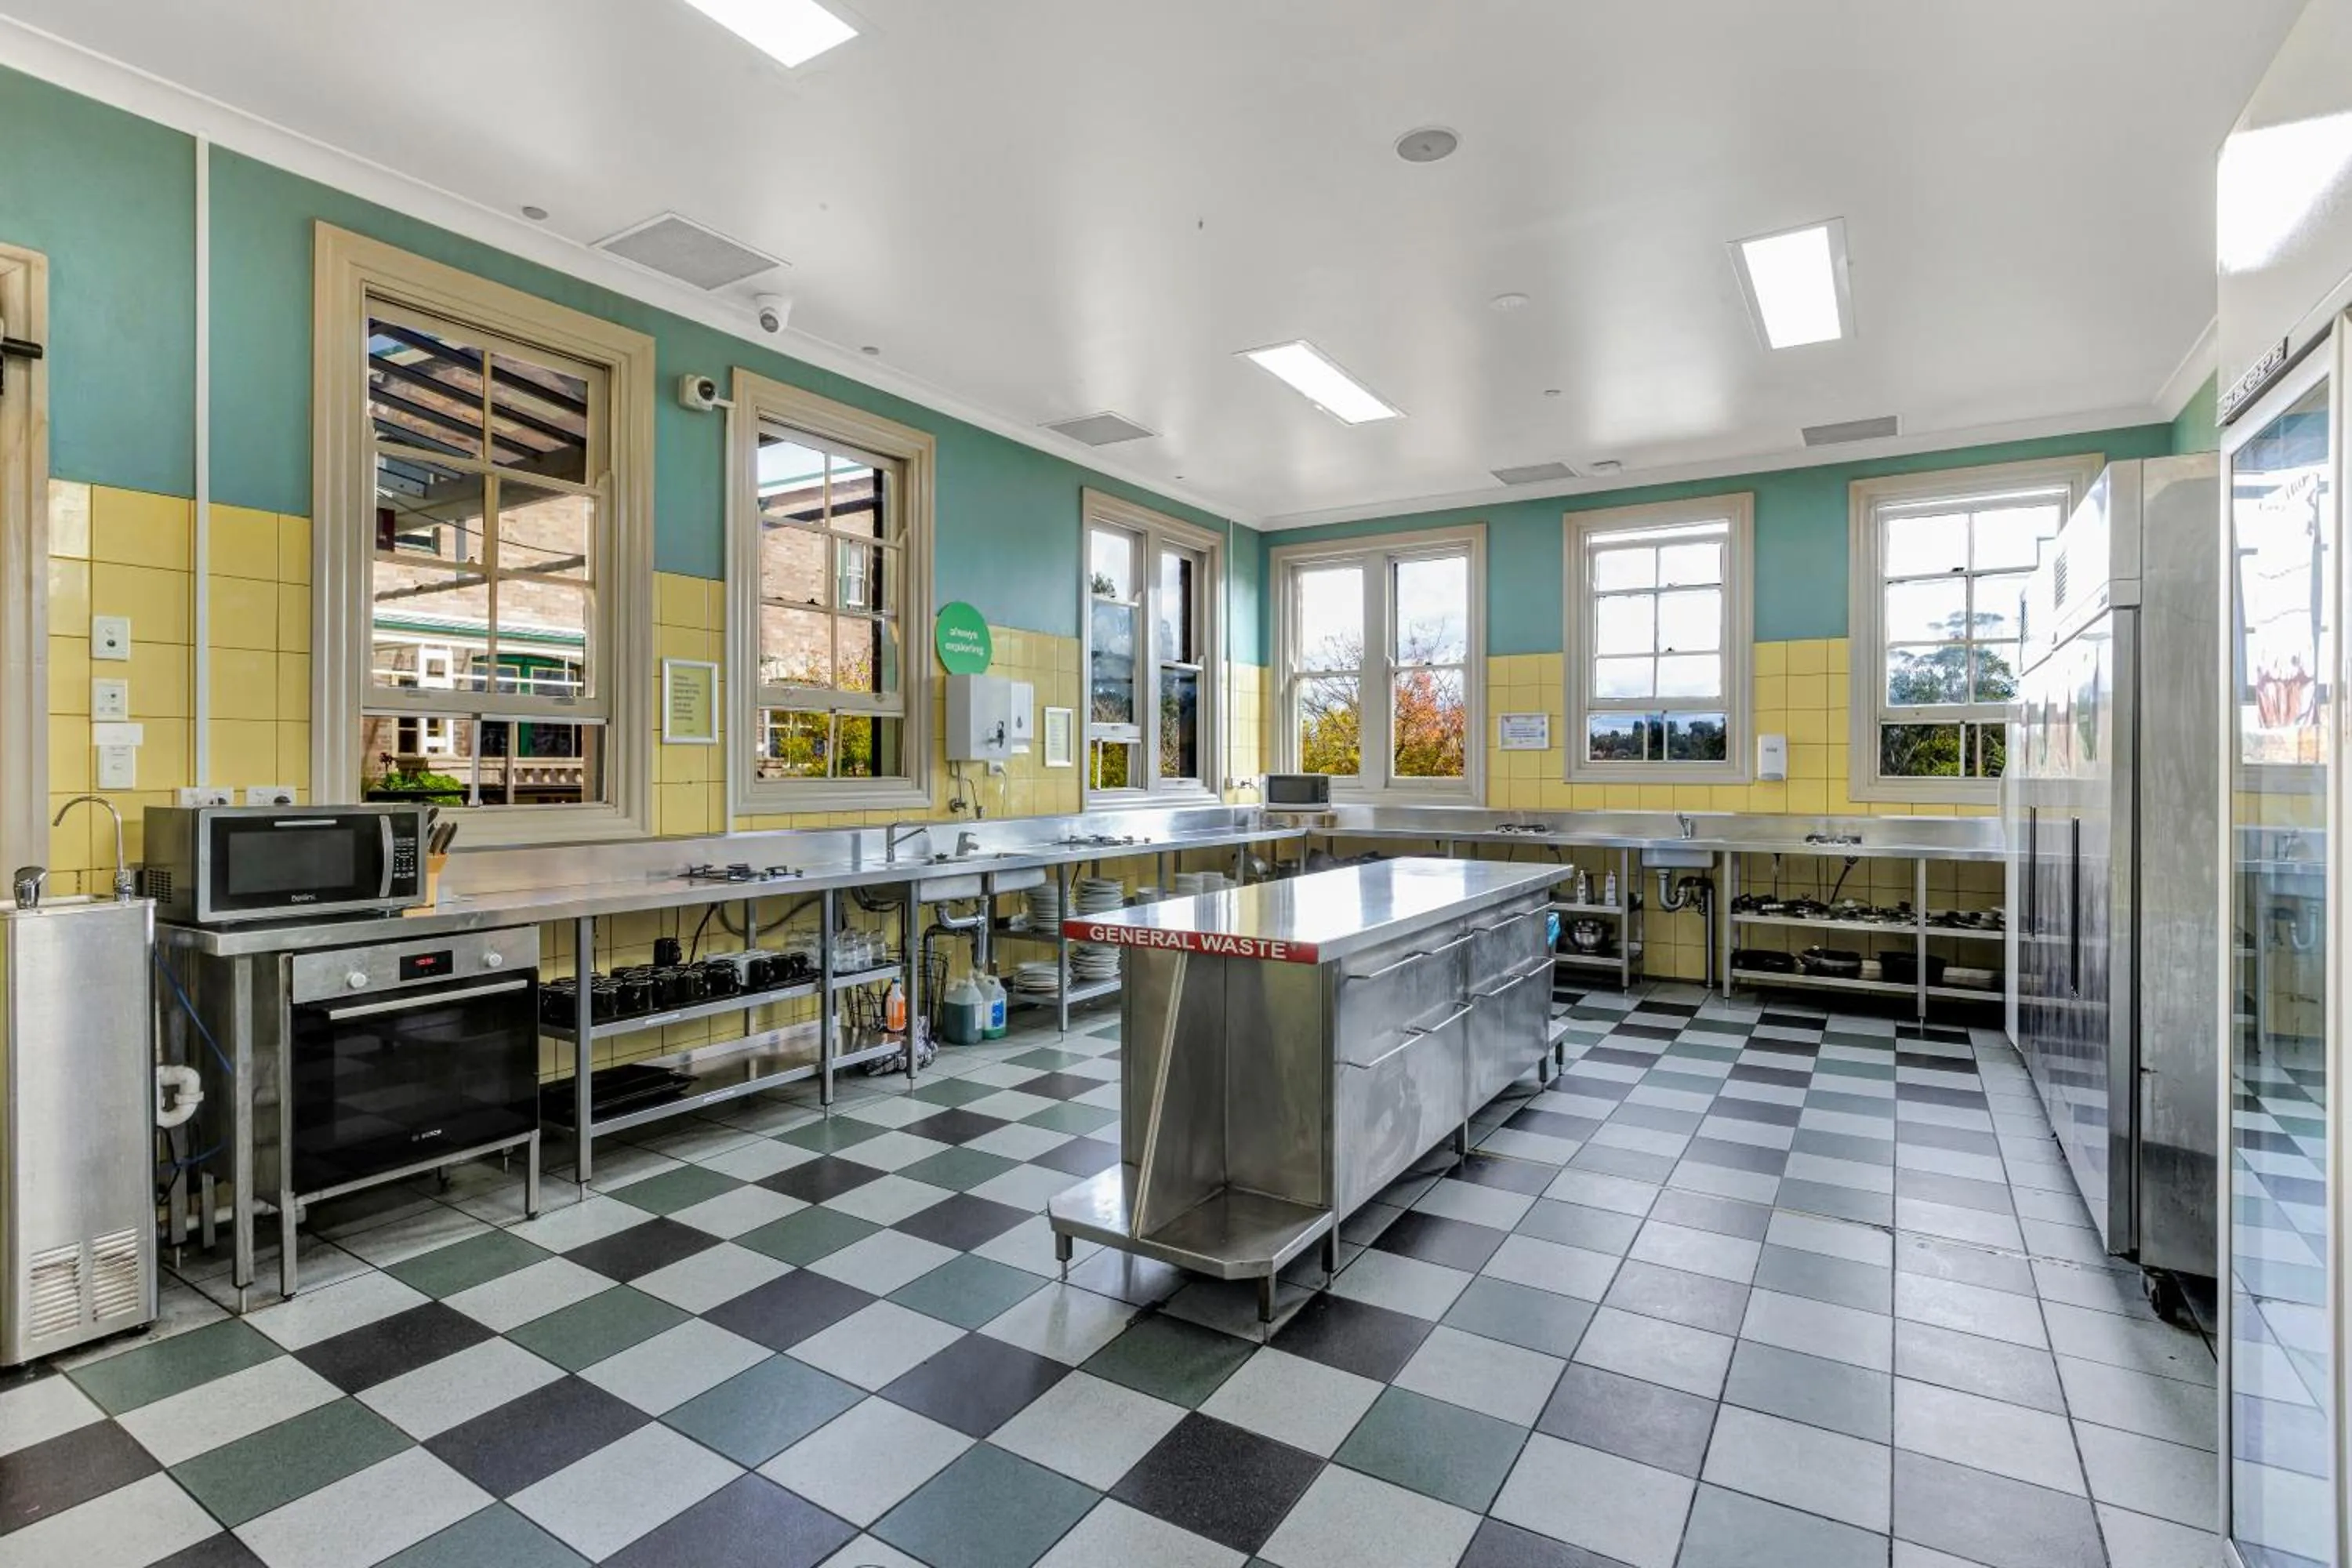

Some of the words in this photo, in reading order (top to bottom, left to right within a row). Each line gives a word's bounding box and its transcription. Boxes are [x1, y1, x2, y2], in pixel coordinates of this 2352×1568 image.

[949, 626, 978, 641] always
[945, 642, 984, 657] exploring
[1089, 924, 1196, 950] GENERAL
[1200, 933, 1287, 959] WASTE
